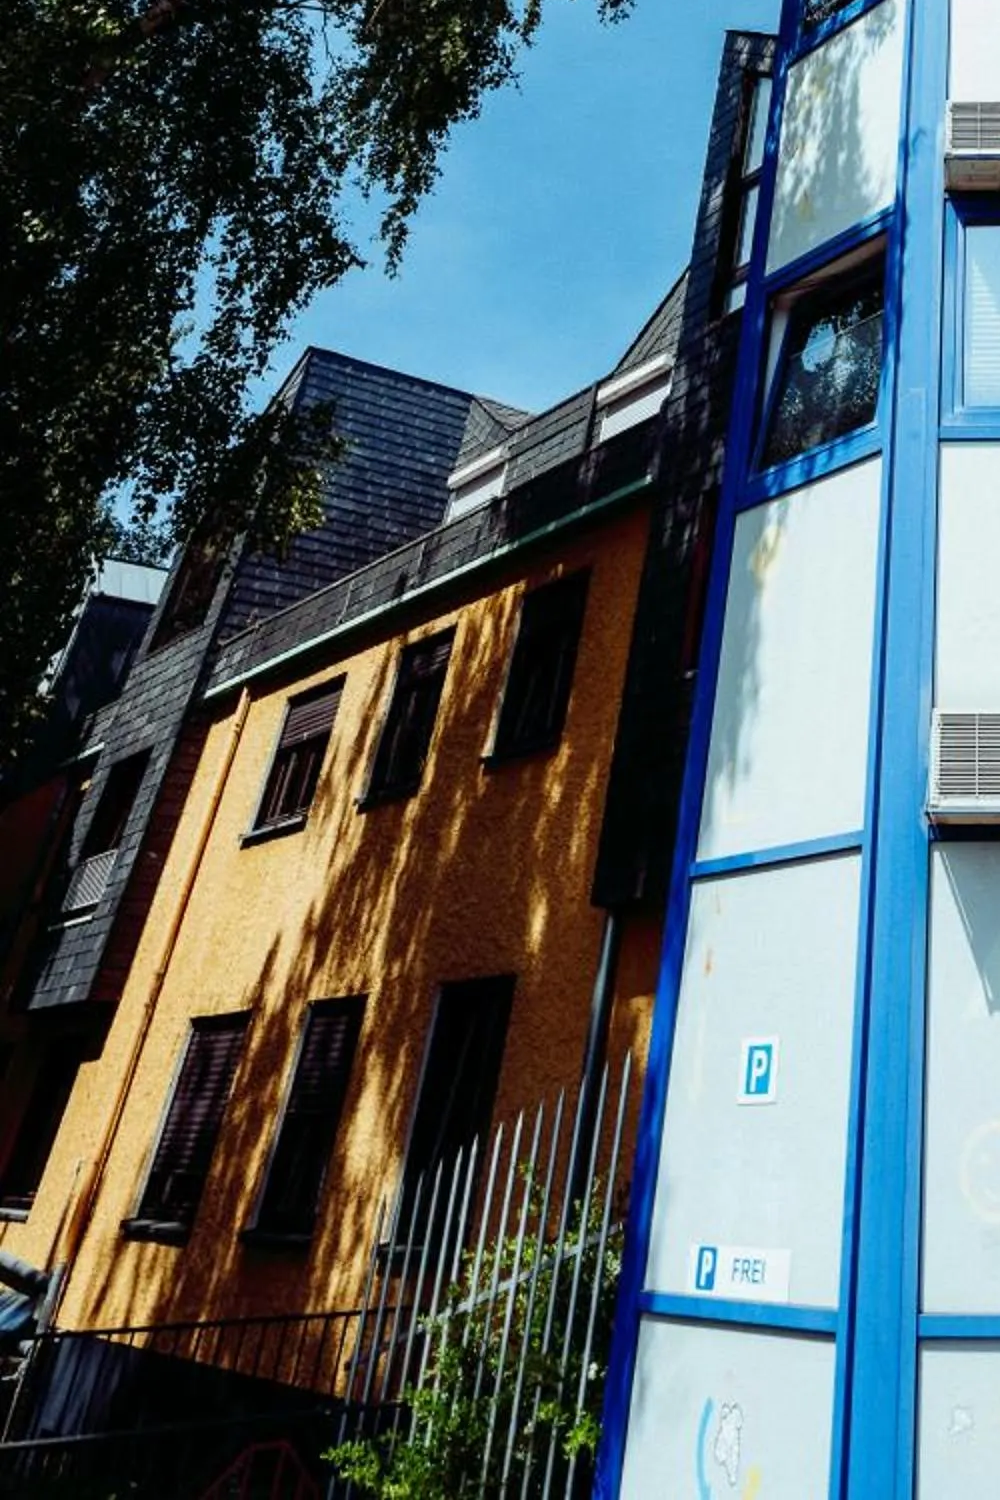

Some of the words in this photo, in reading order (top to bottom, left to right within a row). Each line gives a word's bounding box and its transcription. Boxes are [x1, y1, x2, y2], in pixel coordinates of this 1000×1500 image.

[749, 1048, 769, 1094] P
[699, 1249, 716, 1288] P
[731, 1257, 767, 1284] FREI
